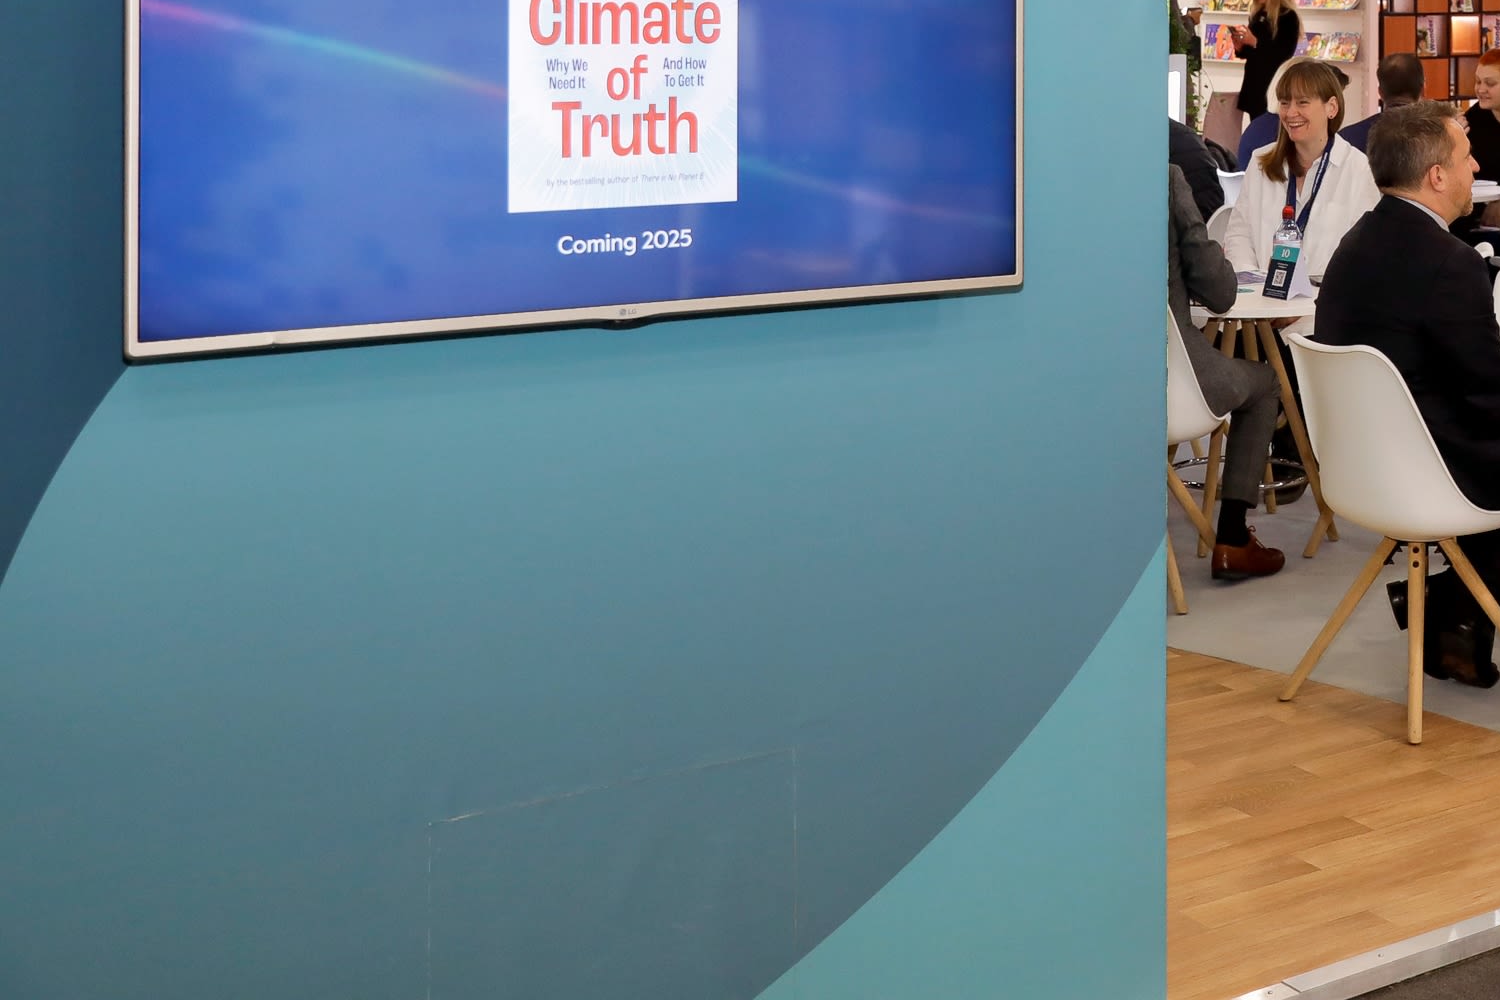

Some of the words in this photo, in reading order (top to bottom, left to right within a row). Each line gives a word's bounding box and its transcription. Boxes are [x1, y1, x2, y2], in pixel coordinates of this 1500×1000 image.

[546, 58, 569, 75] Why
[571, 58, 588, 72] We
[663, 57, 683, 71] And
[685, 56, 707, 70] How
[548, 75, 575, 90] Need
[577, 75, 586, 89] It
[606, 54, 649, 101] of
[664, 74, 676, 88] To
[678, 74, 695, 87] Get
[697, 73, 705, 86] It
[551, 96, 699, 159] Truth
[557, 178, 568, 186] the
[607, 175, 630, 185] author
[557, 233, 638, 257] Coming
[641, 228, 693, 250] 2025
[1281, 248, 1291, 258] 10
